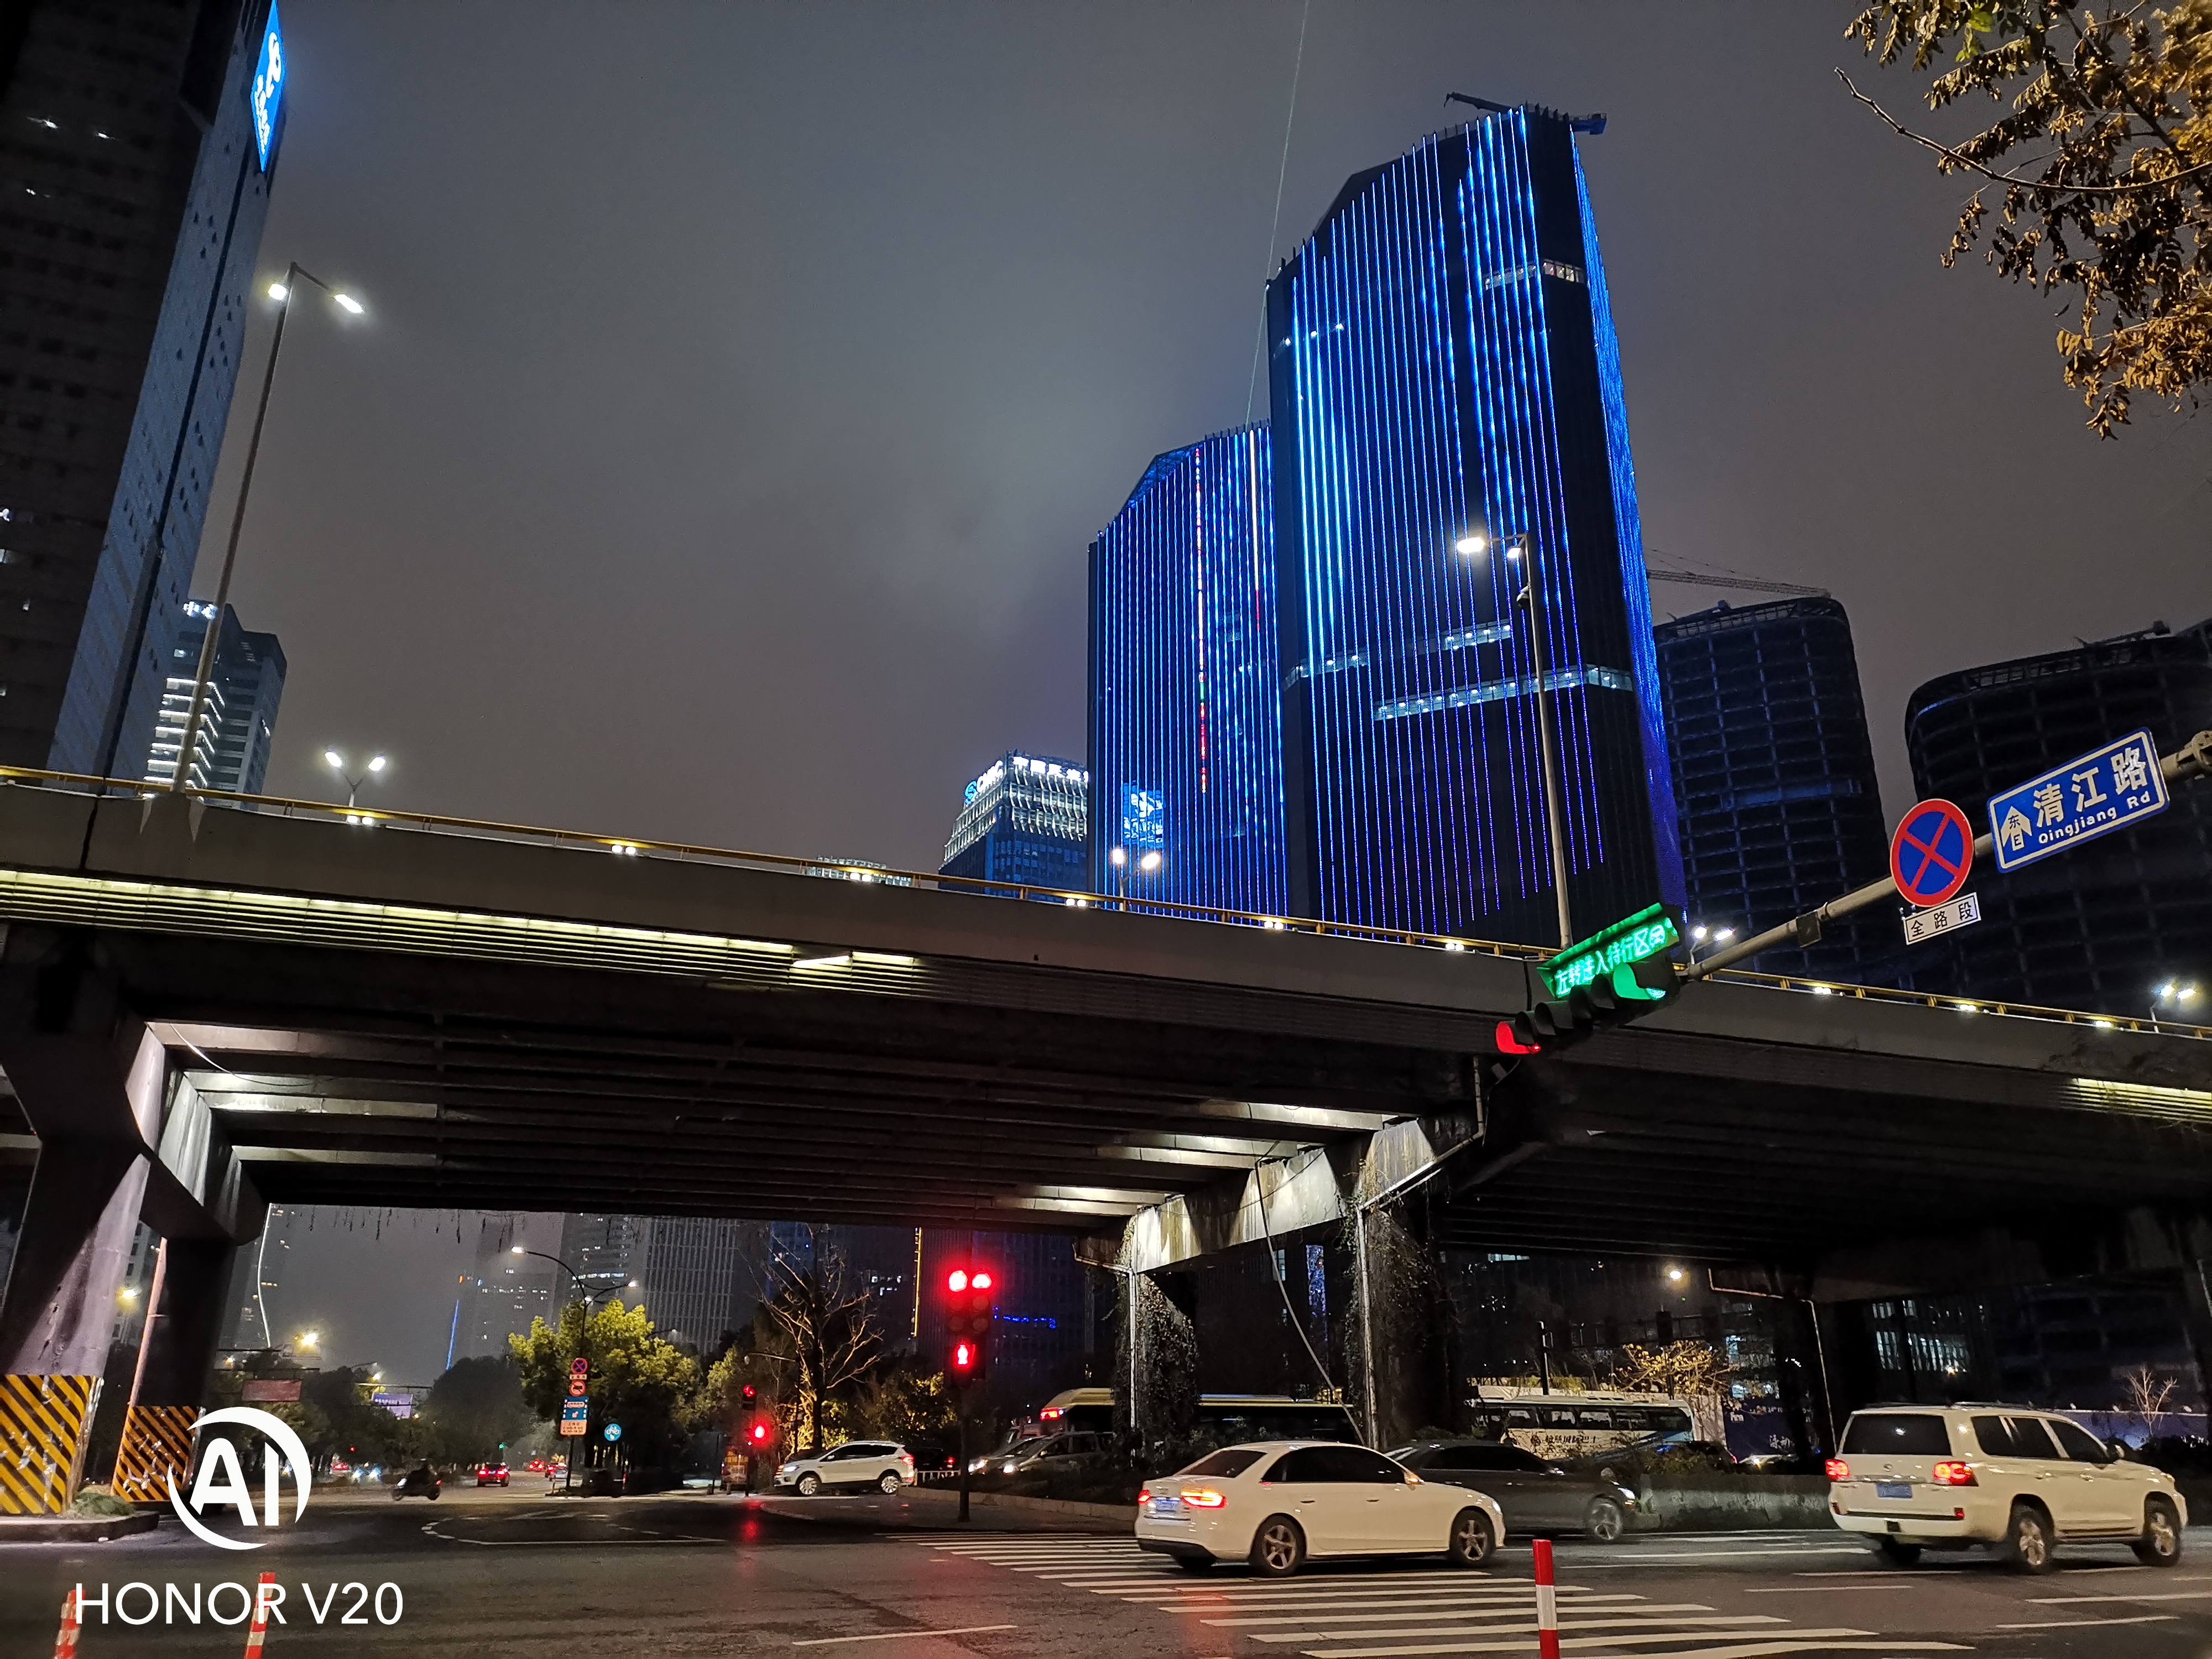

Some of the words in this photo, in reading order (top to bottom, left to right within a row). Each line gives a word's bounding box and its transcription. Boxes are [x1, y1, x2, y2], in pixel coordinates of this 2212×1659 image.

[2032, 746, 2147, 828] 清江路
[2008, 814, 2021, 830] 东
[2038, 806, 2117, 845] Qingjiang
[2127, 791, 2151, 810] Rd
[2013, 833, 2023, 848] E
[1911, 901, 1976, 937] 全路段
